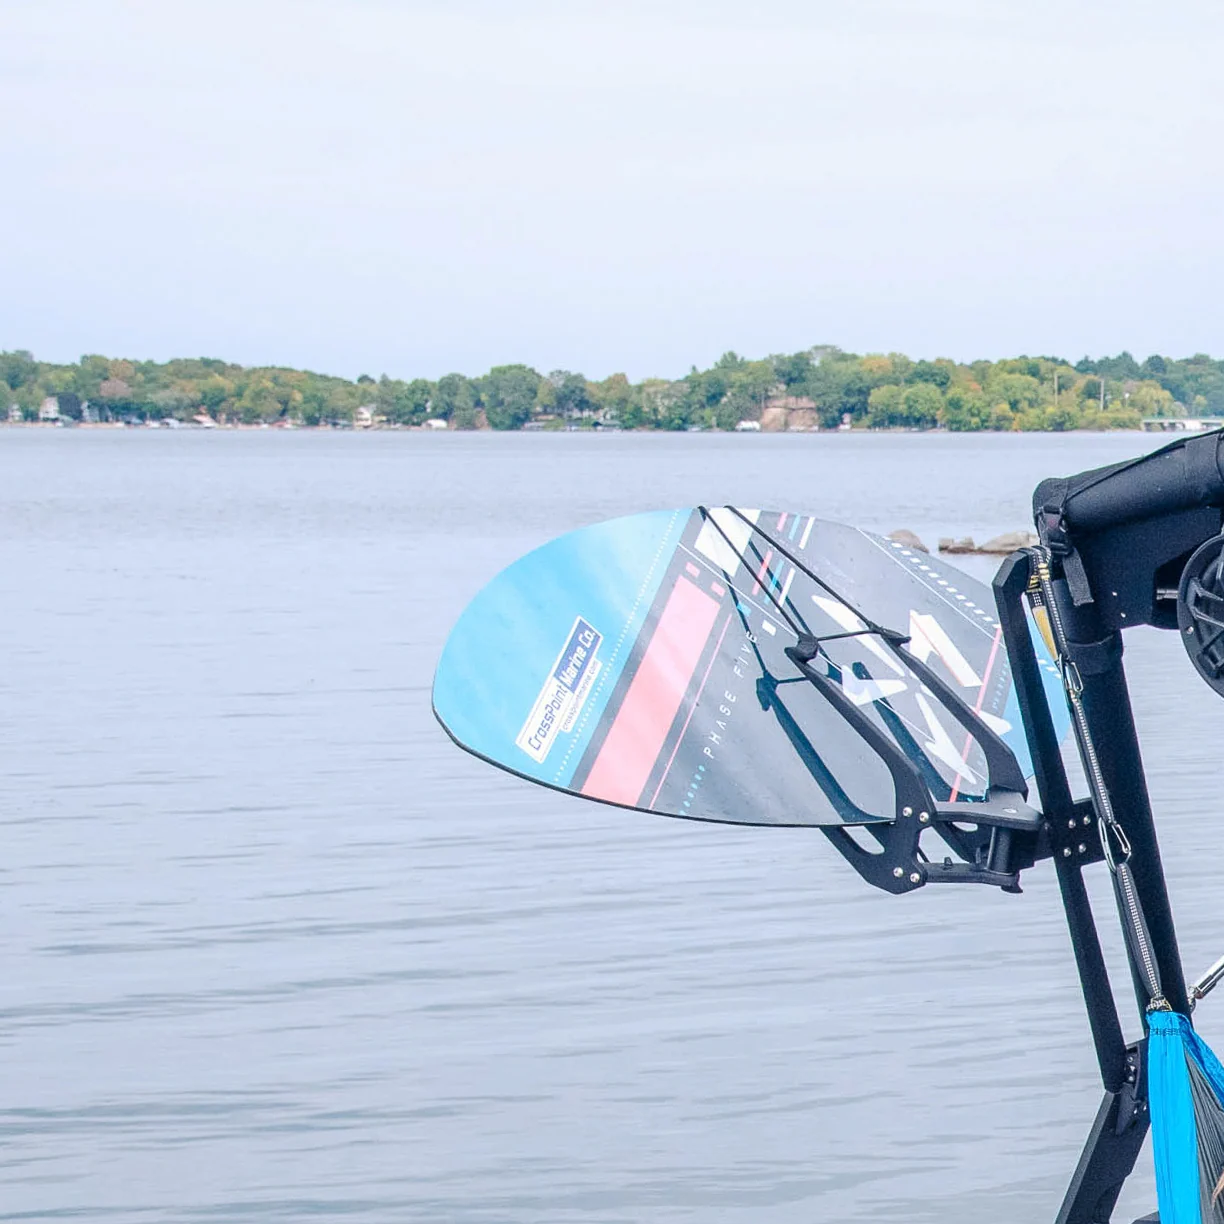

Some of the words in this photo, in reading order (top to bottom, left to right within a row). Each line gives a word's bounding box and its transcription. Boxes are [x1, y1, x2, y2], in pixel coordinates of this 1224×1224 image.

[527, 685, 568, 751] CrossPoint
[558, 645, 587, 688] Marine
[578, 629, 596, 649] Co.
[703, 690, 737, 759] PHASE
[733, 631, 758, 679] FIVE
